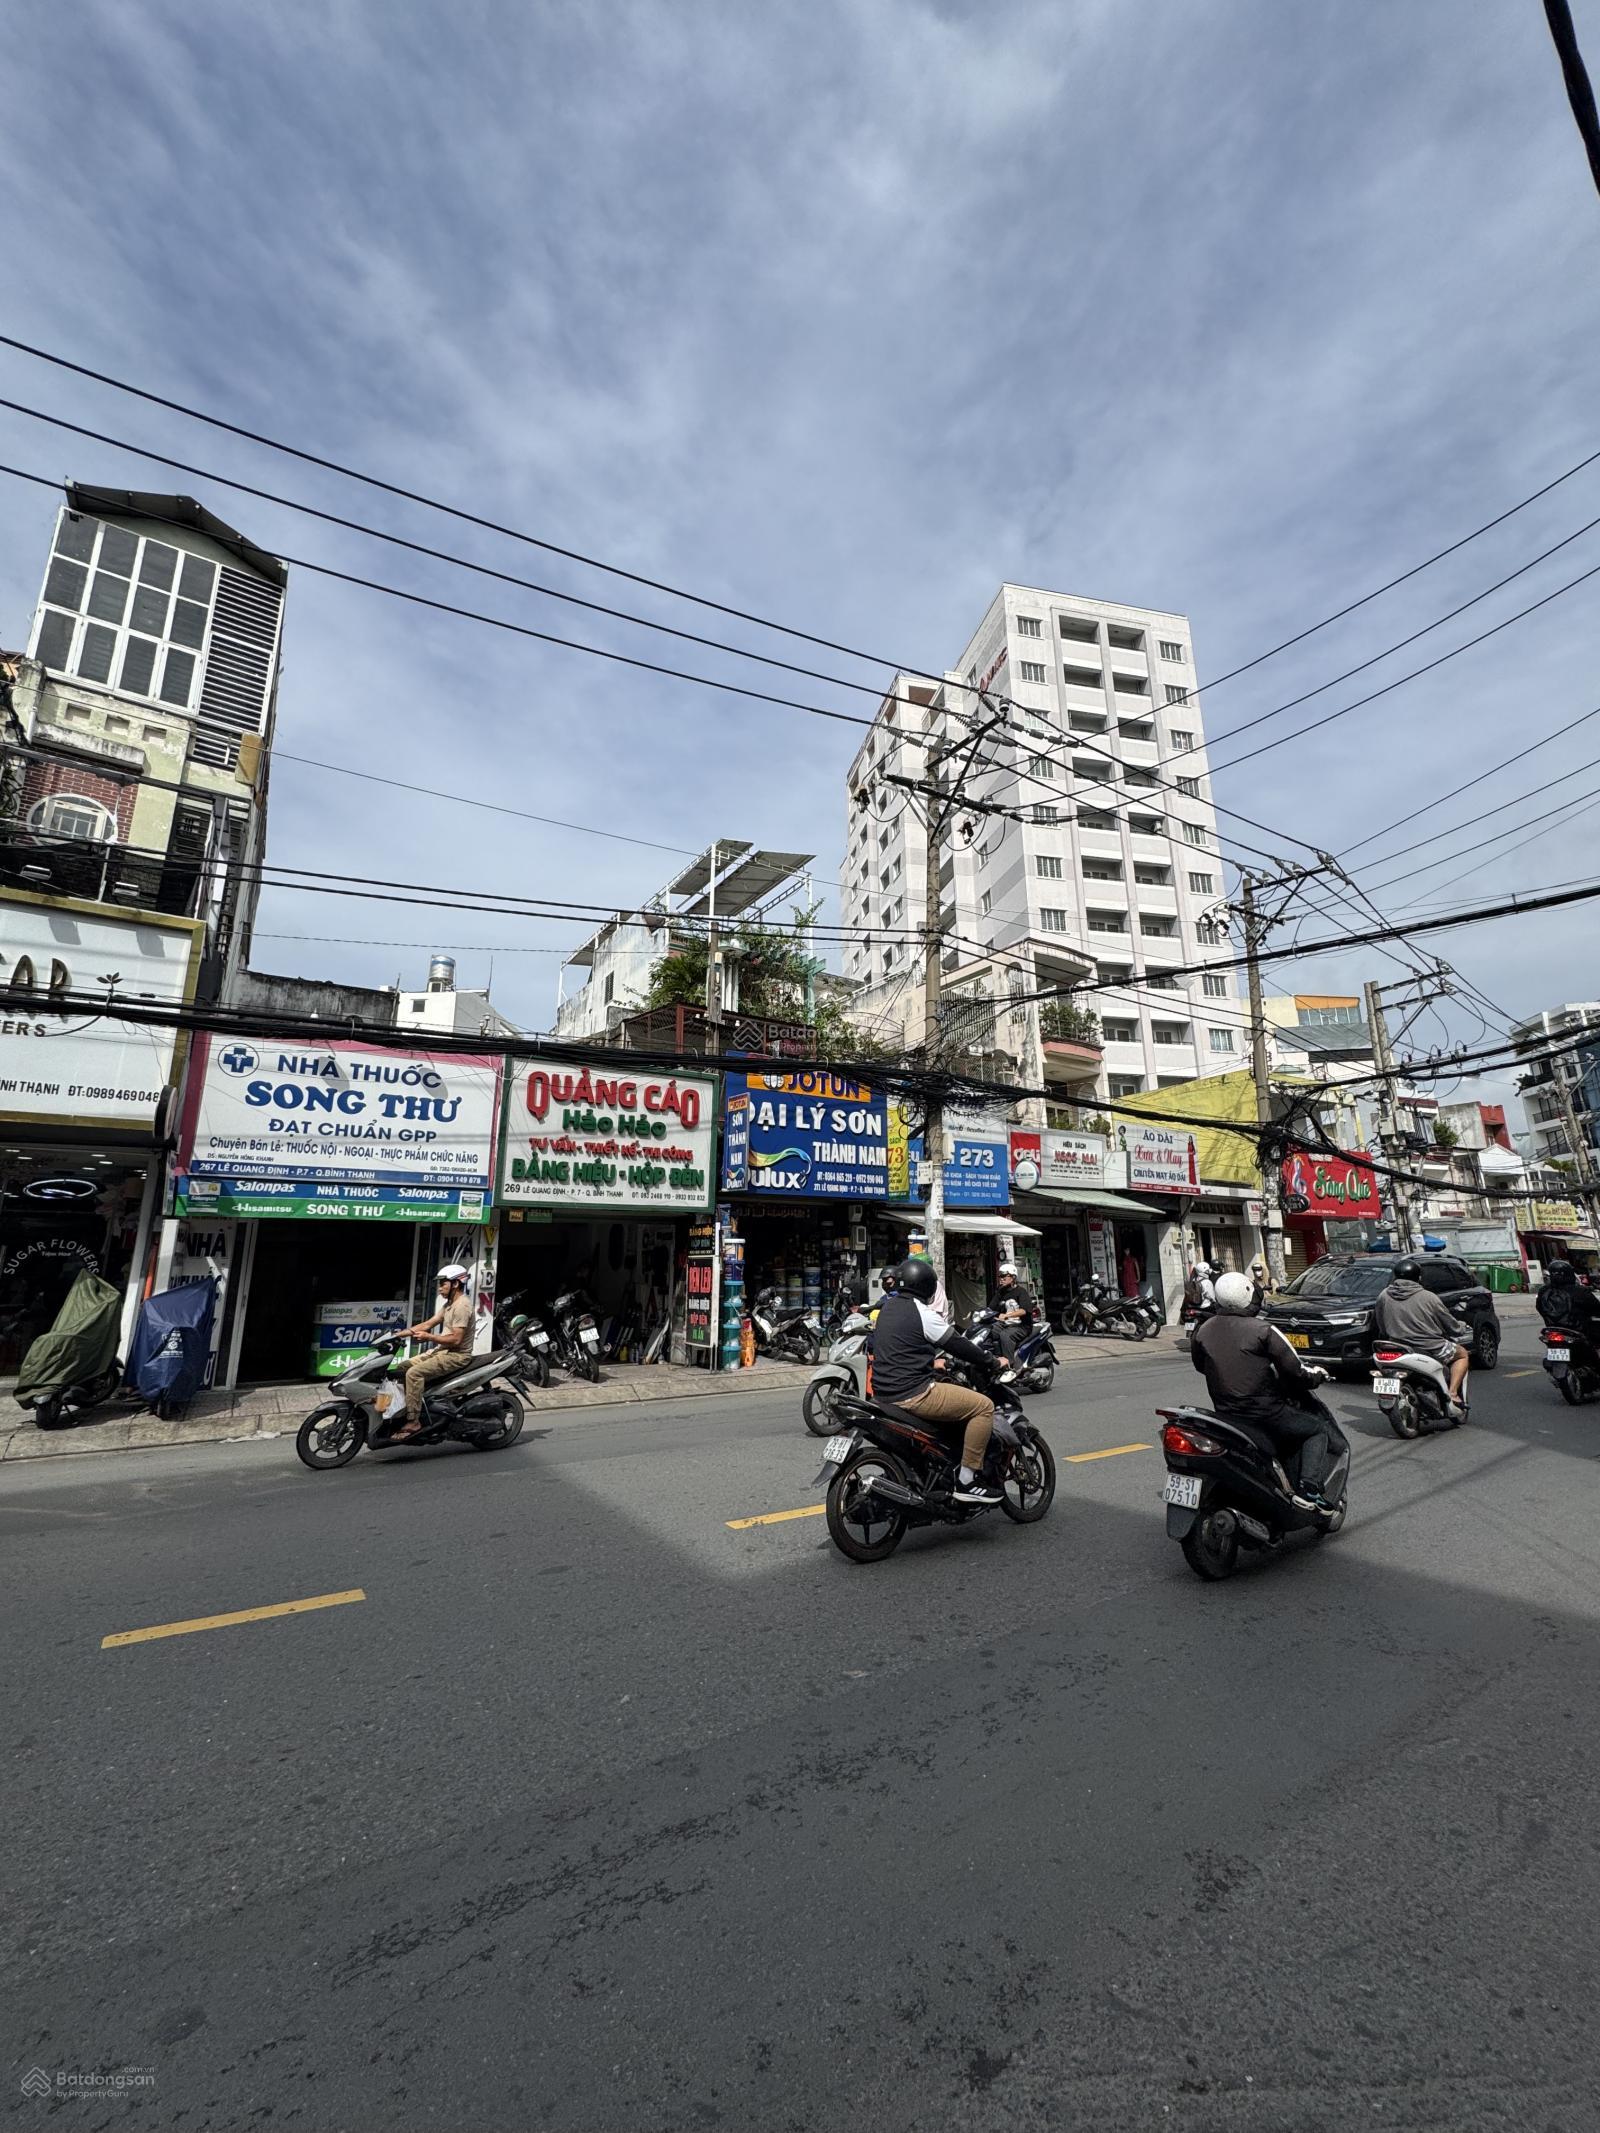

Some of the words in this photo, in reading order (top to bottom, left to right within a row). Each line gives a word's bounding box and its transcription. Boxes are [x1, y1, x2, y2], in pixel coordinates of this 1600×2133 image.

[0, 1020, 47, 1037] ERS
[277, 1054, 340, 1078] NHÀ
[350, 1063, 442, 1088] THUỐC
[19, 1081, 60, 1096] THẠNH
[526, 1067, 637, 1120] QUẢNG
[643, 1079, 700, 1128] CÁO
[245, 1080, 366, 1115] SONG
[378, 1093, 462, 1123] THƯ
[268, 1118, 312, 1137] ĐẠT
[317, 1119, 392, 1141] CHUẨN
[398, 1128, 437, 1143] GPP
[796, 1103, 827, 1130] LÝ
[831, 1109, 882, 1136] SƠN
[1143, 1129, 1155, 1141] ÁO
[209, 1136, 248, 1152] Chuyên
[250, 1139, 268, 1151] Bán
[286, 1139, 319, 1154] THUỐC
[320, 1144, 337, 1158] NỘI
[344, 1146, 374, 1160] NGOẠI
[381, 1148, 403, 1162] THỰC
[812, 1138, 857, 1165] THÀNH
[858, 1145, 887, 1167] NAM
[960, 1148, 994, 1168] 273
[199, 1163, 215, 1172] 267
[218, 1162, 231, 1173] LÊ
[232, 1164, 265, 1175] QUANG
[267, 1167, 289, 1176] ĐỊNH
[296, 1169, 309, 1177] P.7
[347, 1171, 375, 1180] THẠNH
[511, 1151, 569, 1182] BẢNG
[234, 1180, 297, 1194] Salonpas
[316, 1183, 339, 1196] NHÀ
[343, 1184, 380, 1198] THUỐC
[397, 1186, 449, 1200] Salonpas
[504, 1183, 521, 1193] 269
[306, 1203, 349, 1215] SONG
[353, 1204, 386, 1217] THƯ
[3, 1241, 46, 1275] SUGAR
